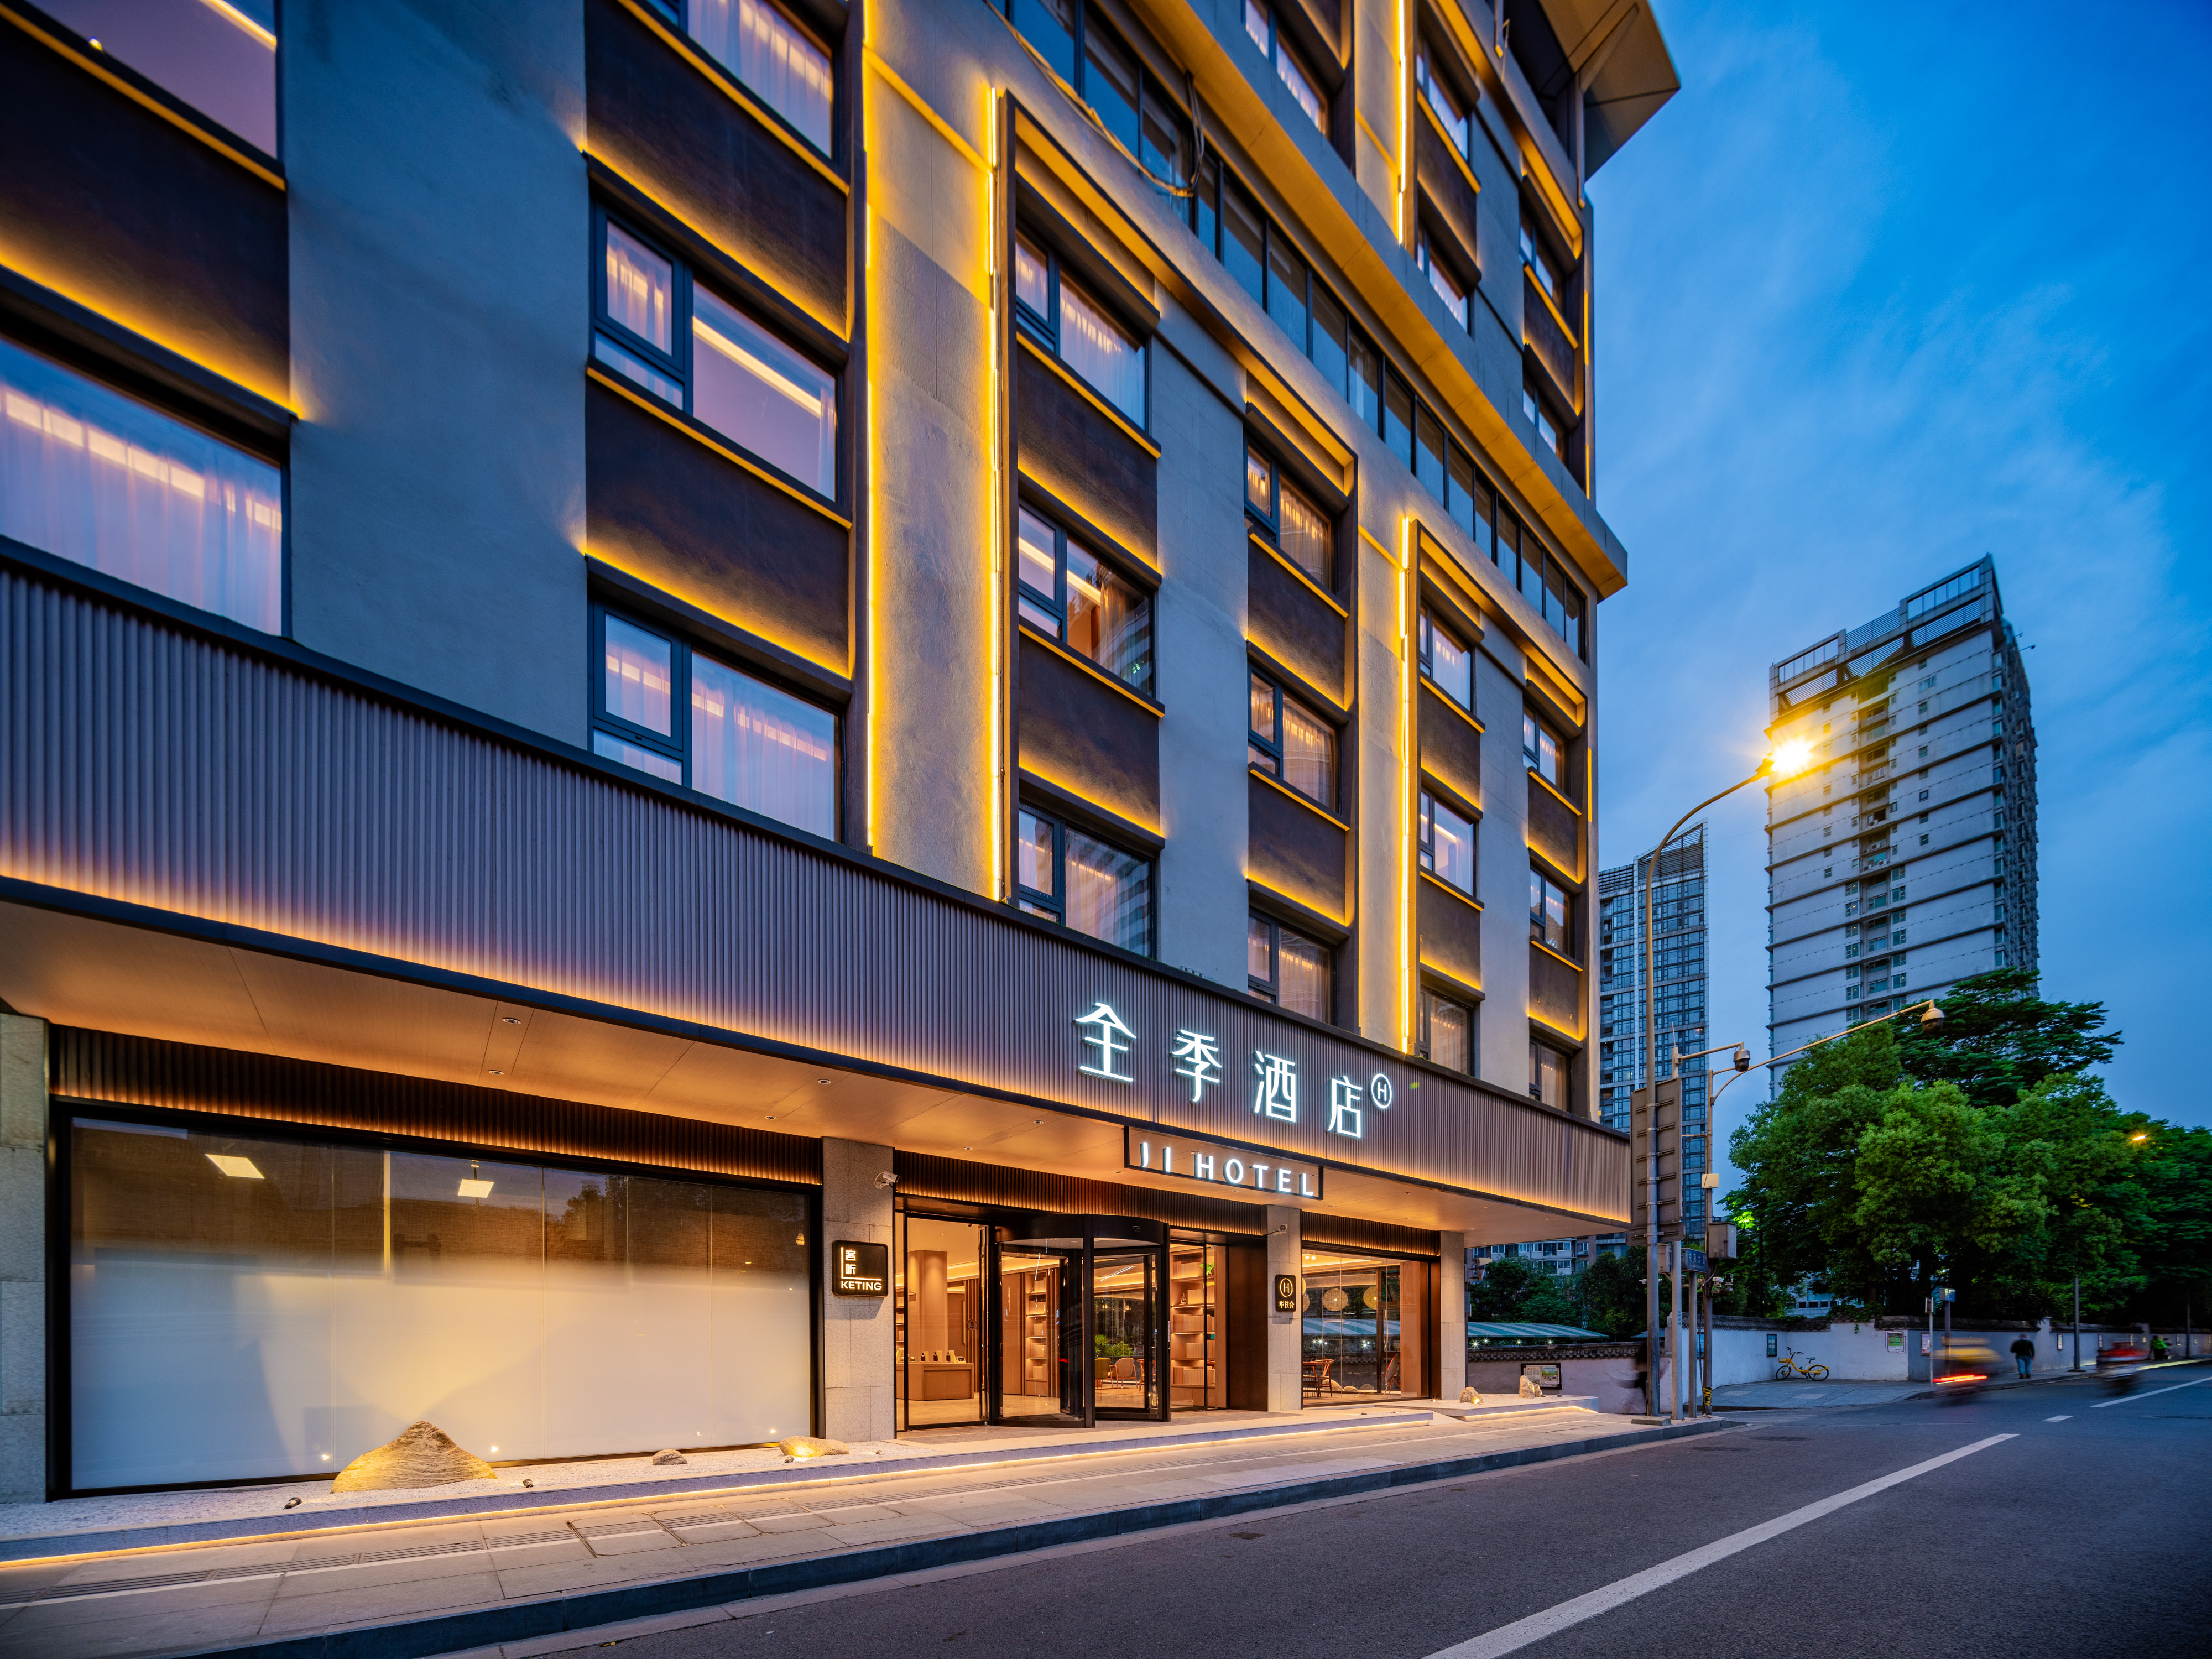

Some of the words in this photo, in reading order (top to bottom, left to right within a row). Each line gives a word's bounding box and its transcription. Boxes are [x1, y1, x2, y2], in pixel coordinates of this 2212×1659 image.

[1075, 1002, 1363, 1139] 全季酒店
[1141, 1142, 1171, 1172] JI
[1195, 1152, 1314, 1196] HOTEL
[845, 1249, 857, 1275] 客听
[841, 1280, 882, 1291] KETING
[1279, 1300, 1295, 1309] 华住会
